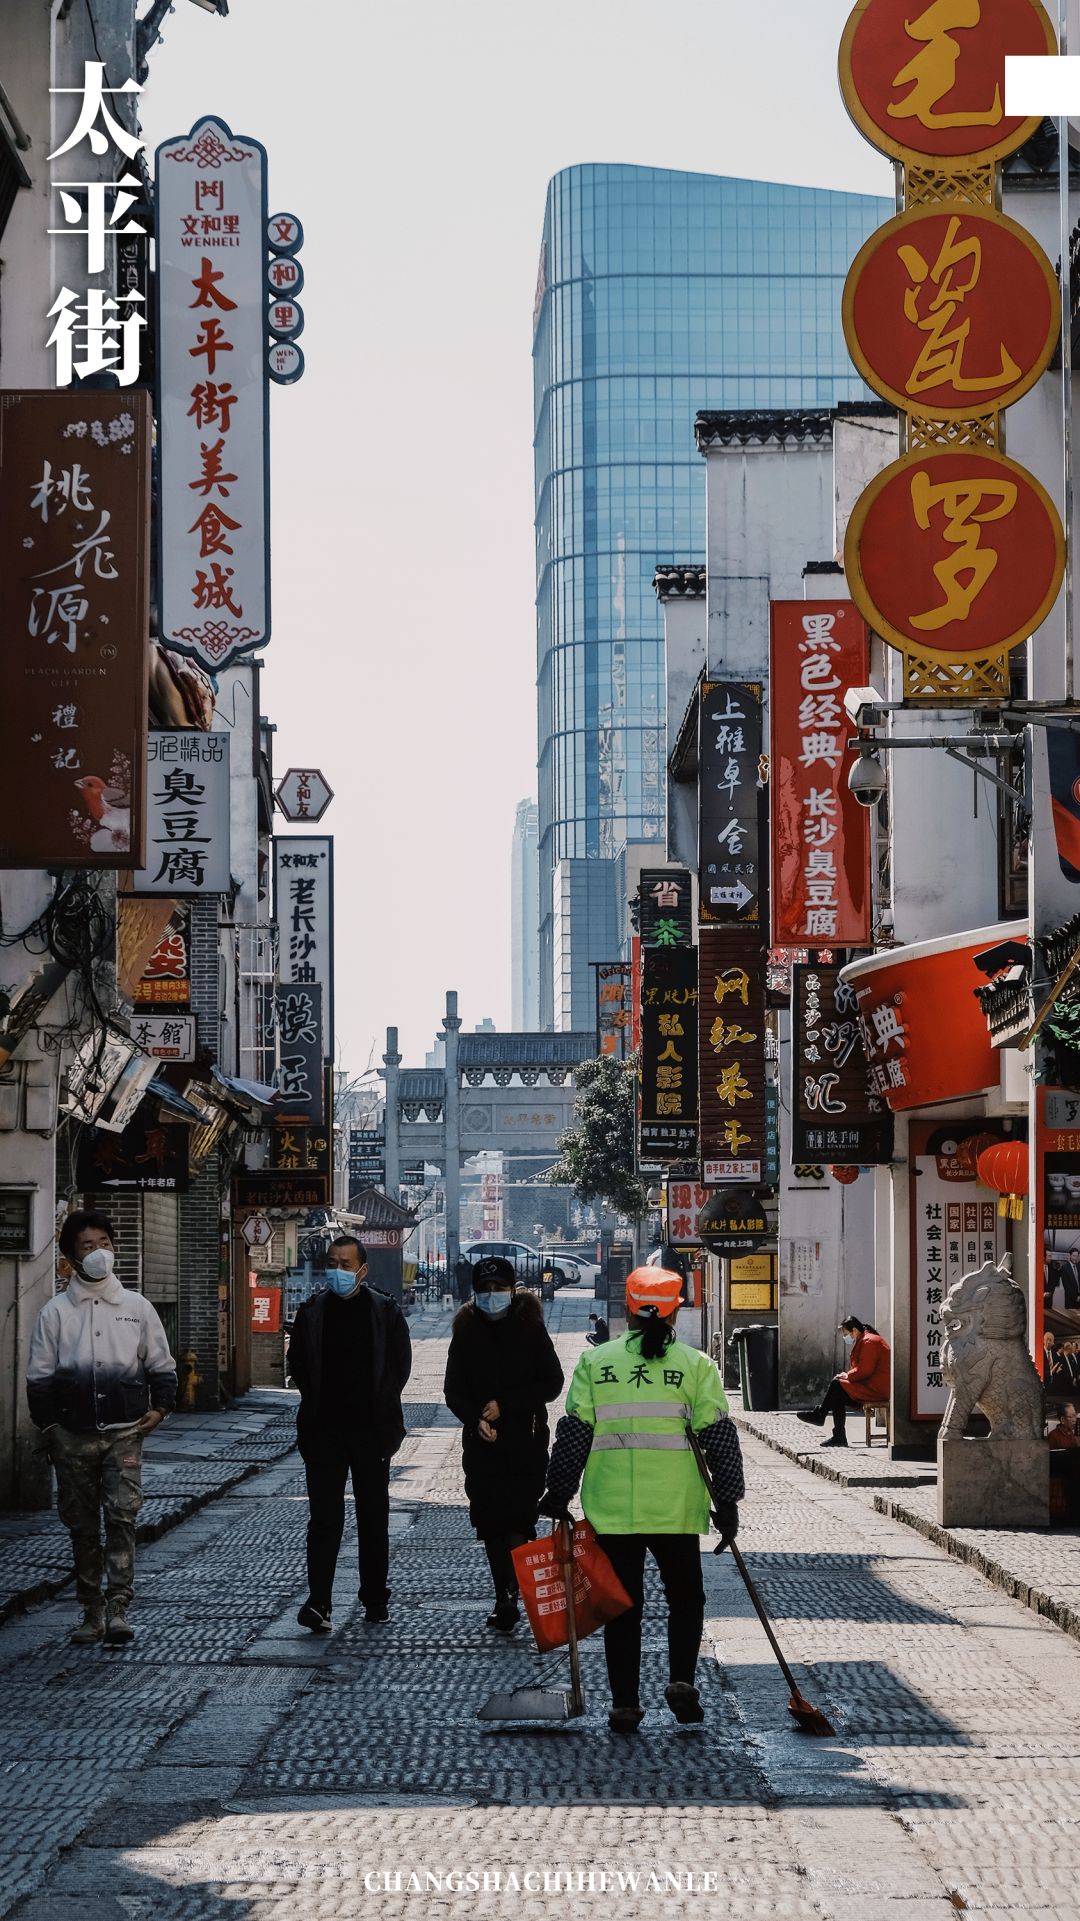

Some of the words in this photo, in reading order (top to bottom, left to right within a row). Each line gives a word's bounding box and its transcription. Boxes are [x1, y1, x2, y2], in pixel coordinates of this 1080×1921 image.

[180, 214, 240, 236] 文和里
[180, 237, 240, 248] WENHELI
[272, 218, 296, 329] 文和里
[275, 350, 295, 358] WEN
[186, 256, 243, 619] 太平街美食城
[28, 459, 118, 653] 桃花源
[798, 613, 842, 770] 黑色经典
[51, 702, 80, 769] 禮記
[296, 774, 312, 817] 文和友
[152, 767, 212, 887] 臭豆腐
[280, 853, 320, 868] 文和友
[803, 787, 838, 937] 长沙臭豆腐
[600, 966, 631, 980] Frien
[136, 1022, 185, 1046] 茶館
[656, 1014, 684, 1117] 私人影院
[708, 967, 758, 1156] 网红采耳
[676, 1141, 690, 1149] 2F
[826, 1130, 859, 1144] 洗手间
[706, 1163, 759, 1175] 由手机之家上二楼
[138, 1178, 177, 1188] 十年老店
[729, 1218, 765, 1231] 私人影院
[949, 1206, 960, 1230] 国家
[966, 1206, 977, 1230] 社会
[983, 1206, 994, 1230] 公民
[949, 1241, 960, 1263] 富强
[967, 1241, 977, 1263] 自由
[983, 1241, 994, 1262] 爱国
[925, 1203, 943, 1388] 社会主义核心价值观
[594, 1362, 686, 1390] 玉禾田
